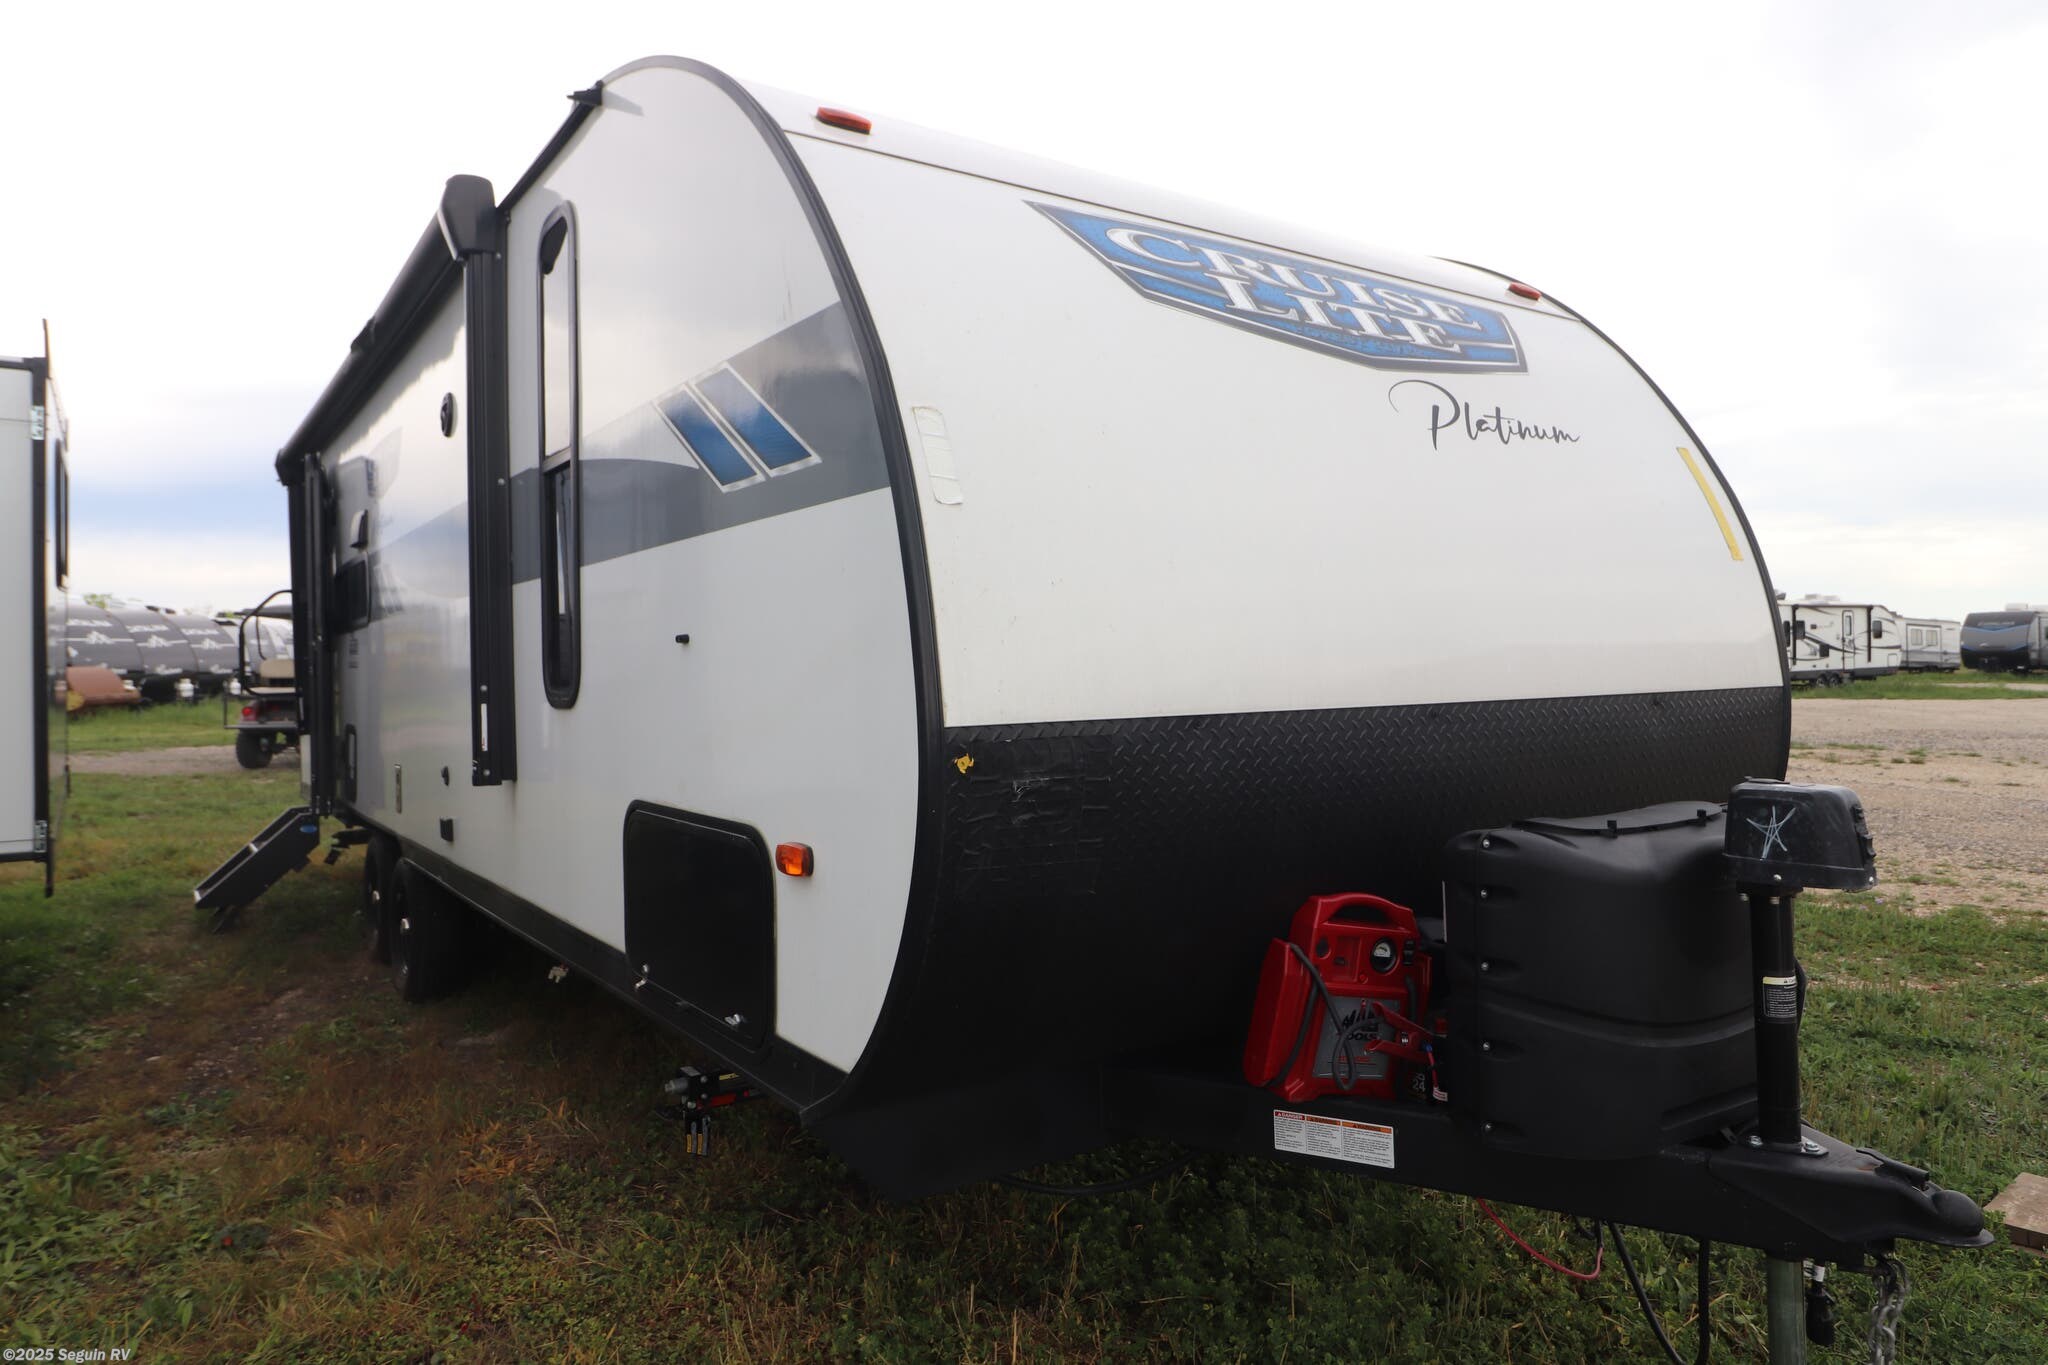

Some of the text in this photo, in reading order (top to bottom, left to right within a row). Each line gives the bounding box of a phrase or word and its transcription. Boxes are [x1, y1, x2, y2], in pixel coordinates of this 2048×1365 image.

[1105, 227, 1482, 331] CRUISE
[1203, 272, 1462, 353] LITE
[1388, 379, 1580, 450] Platinum
